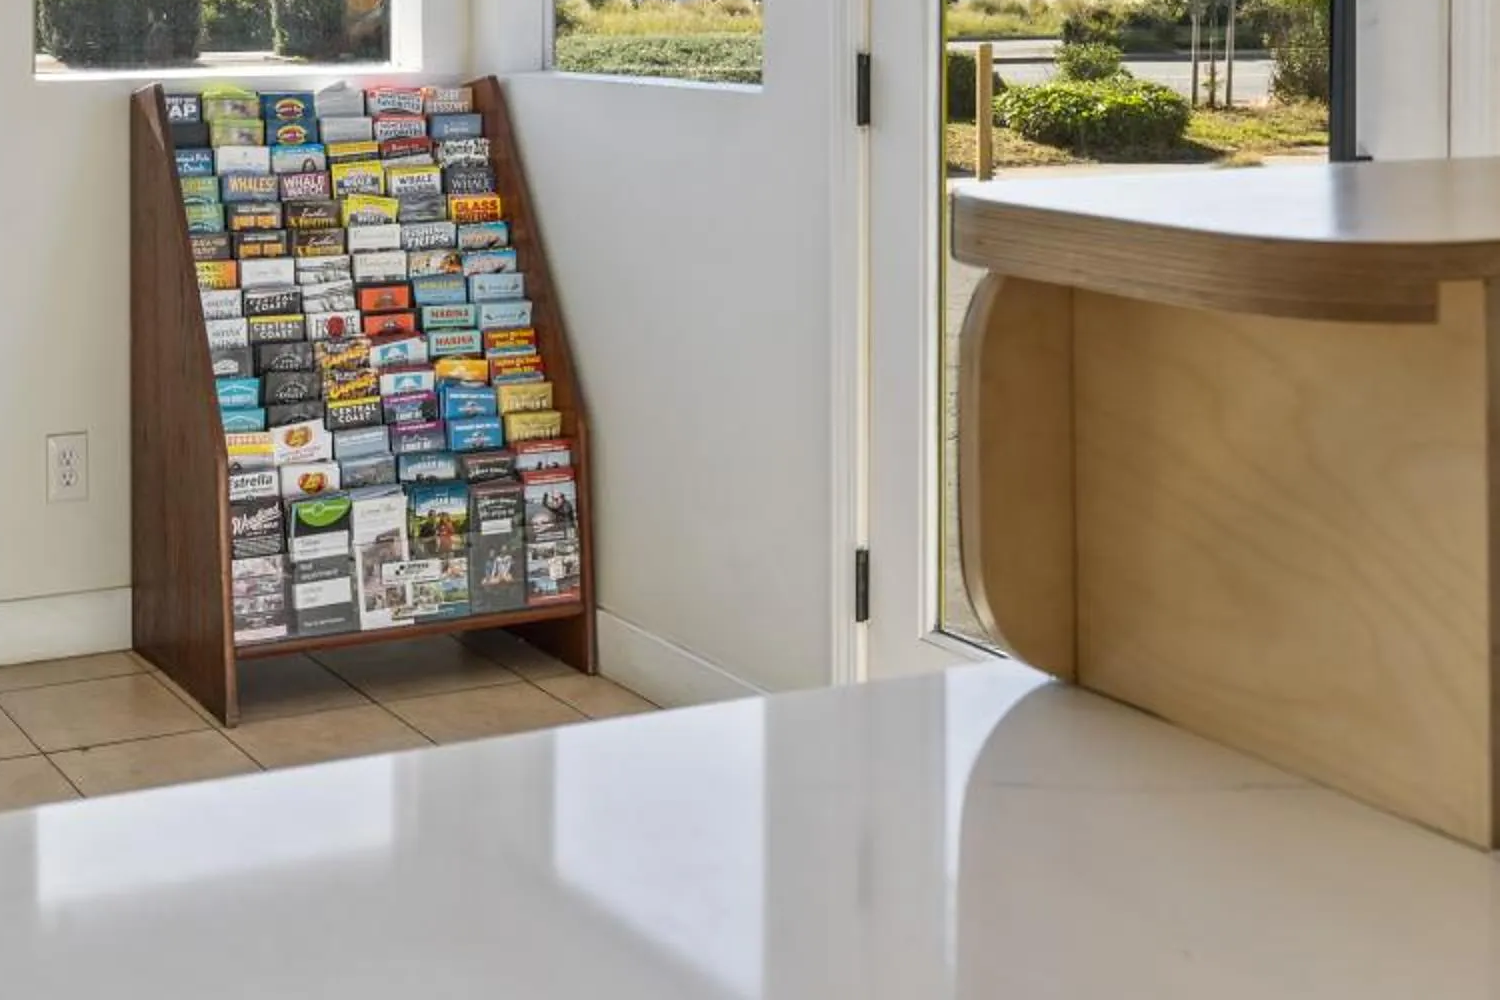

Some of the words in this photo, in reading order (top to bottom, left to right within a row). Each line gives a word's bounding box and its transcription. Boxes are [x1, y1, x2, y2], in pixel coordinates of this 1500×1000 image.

[282, 173, 325, 186] WHALE
[455, 199, 498, 211] GLASS
[254, 301, 288, 313] COAST
[253, 322, 300, 331] CENTRAL
[259, 330, 293, 339] COAST
[332, 404, 377, 417] CENTRAL
[338, 412, 371, 423] COAST
